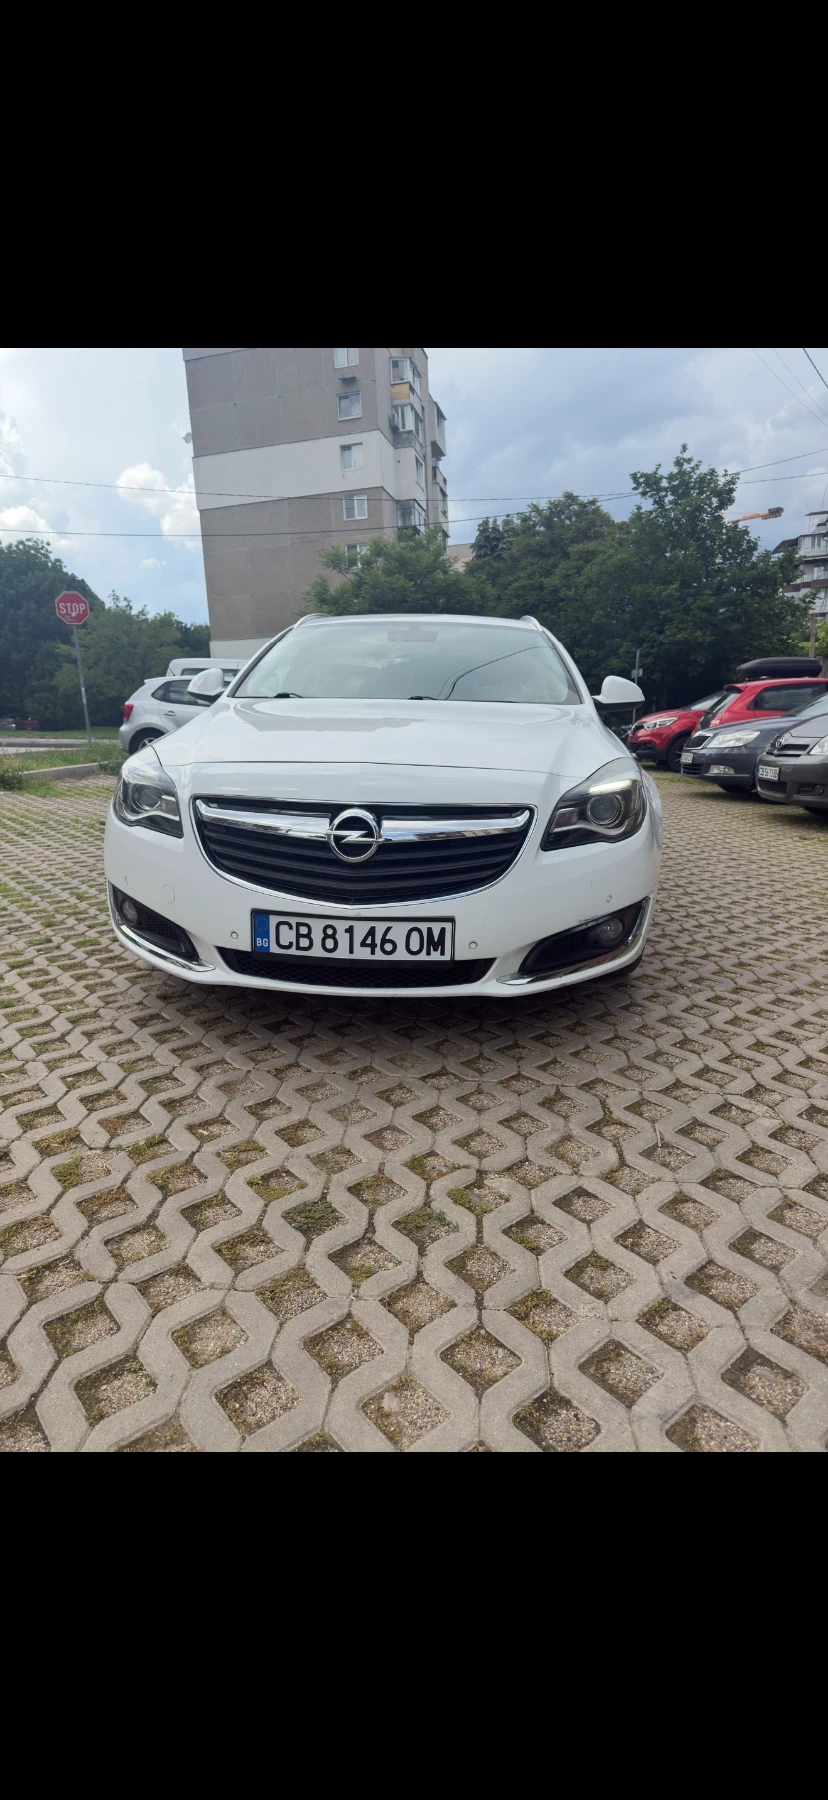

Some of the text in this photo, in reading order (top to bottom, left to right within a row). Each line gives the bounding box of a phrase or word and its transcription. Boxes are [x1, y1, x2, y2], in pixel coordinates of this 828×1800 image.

[59, 602, 85, 614] STOP
[256, 938, 269, 947] BG
[275, 920, 446, 956] CB 8146 OM
